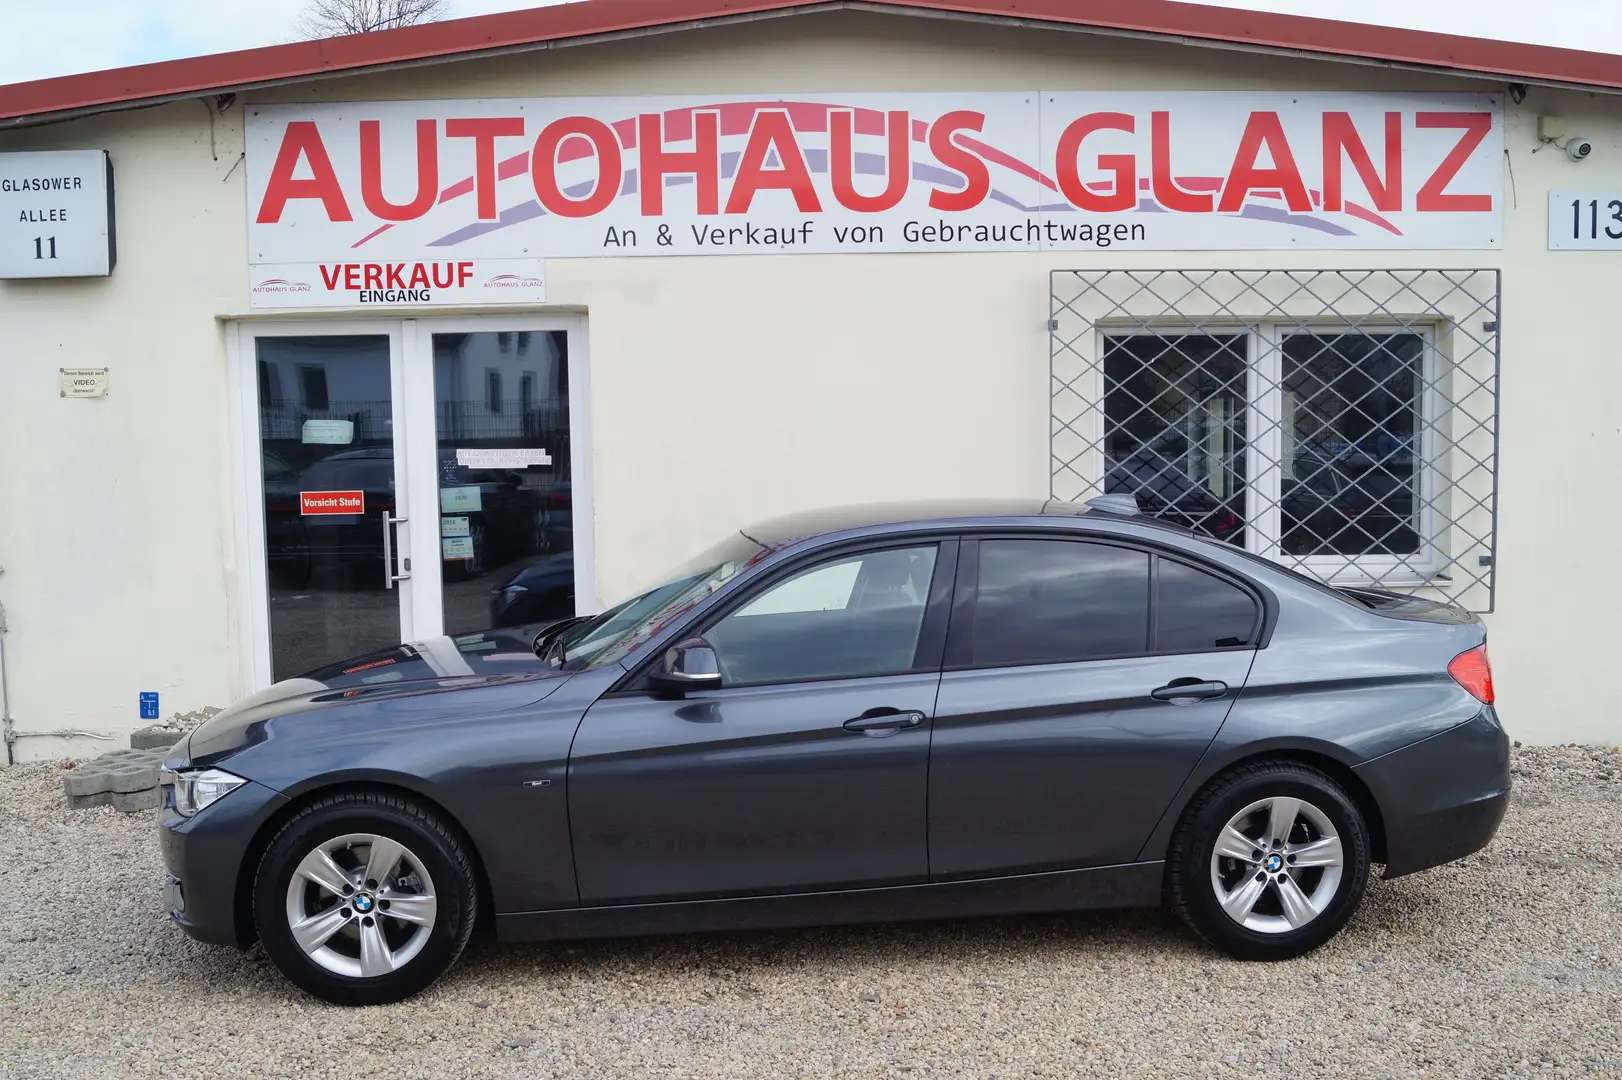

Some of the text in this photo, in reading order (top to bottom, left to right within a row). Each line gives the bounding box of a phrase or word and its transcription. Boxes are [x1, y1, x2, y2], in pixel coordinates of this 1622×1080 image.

[256, 108, 1493, 224] AUTOHAUS GLANZ
[2, 177, 82, 192] GLASOWER
[19, 209, 67, 222] ALLEE
[1571, 199, 1622, 239] 113
[603, 219, 1145, 247] An & Verkauf von Gebrauchtwagen
[33, 236, 58, 260] 11
[319, 261, 473, 291] VERKAUF
[359, 289, 431, 303] EINGANG
[303, 497, 361, 507] Vorsicht Stufe
